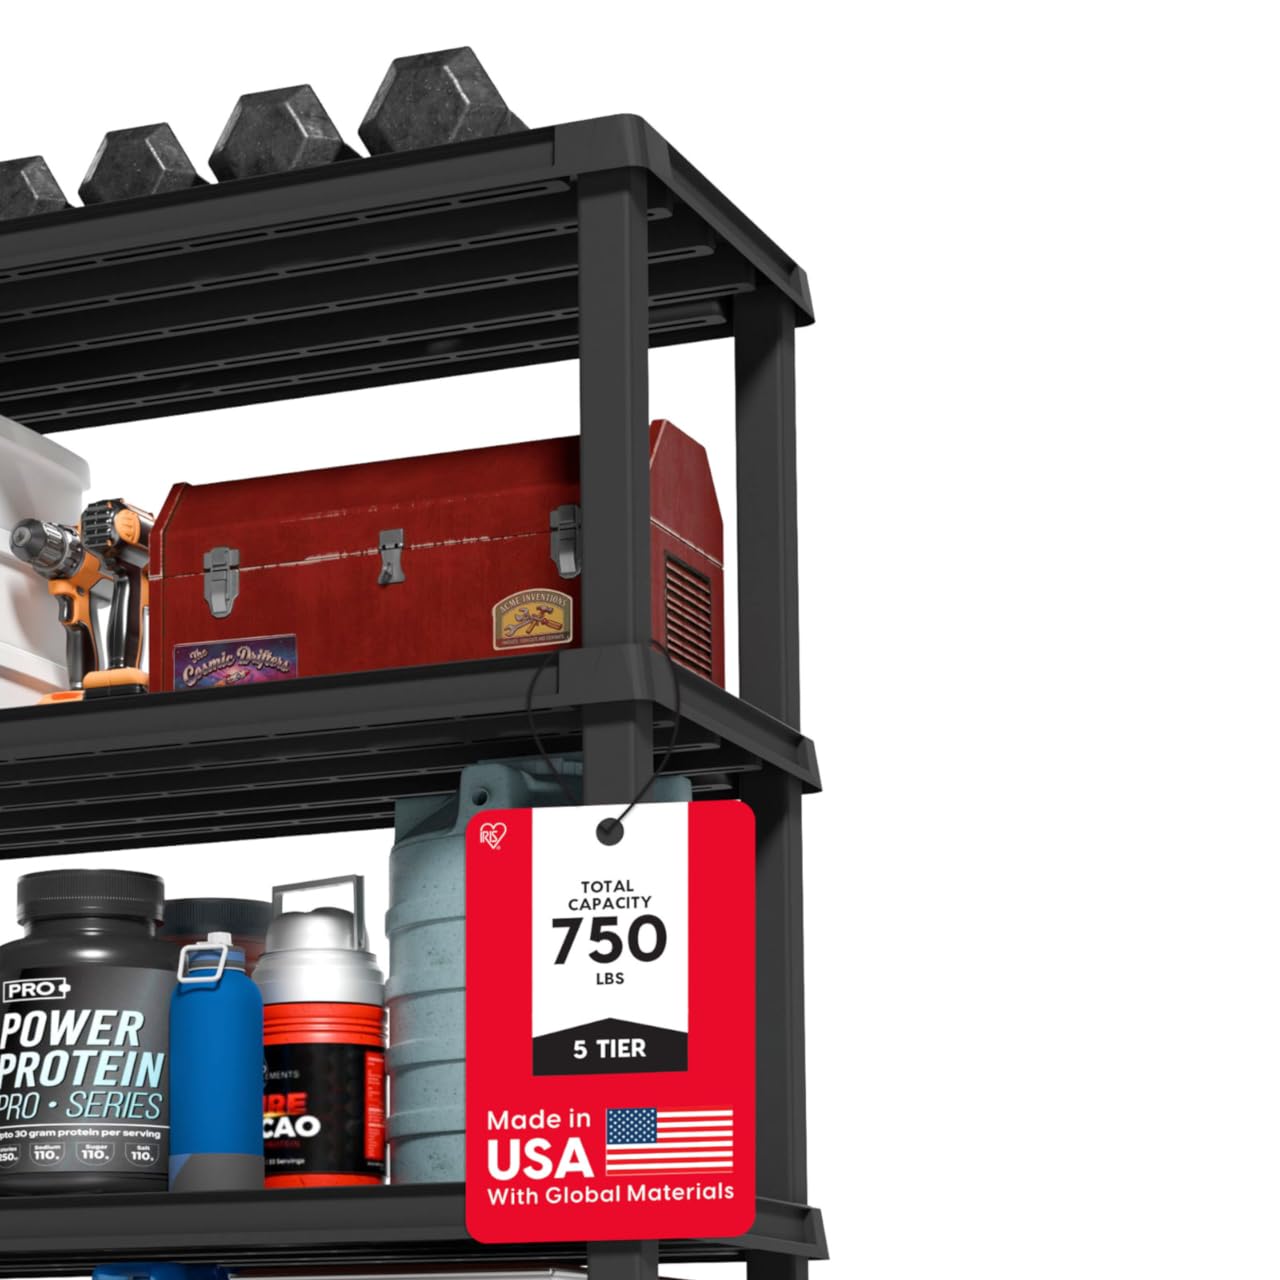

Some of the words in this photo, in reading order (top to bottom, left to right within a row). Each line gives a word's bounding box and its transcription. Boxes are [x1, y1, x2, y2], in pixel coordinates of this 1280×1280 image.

[500, 597, 521, 612] ACME
[522, 592, 568, 607] INVENTIONS
[183, 651, 236, 688] Cosmic
[237, 645, 291, 672] Drifters
[189, 648, 209, 664] The
[581, 880, 634, 893] TOTAL
[568, 896, 652, 911] CAPACITY
[552, 914, 668, 965] 750
[596, 973, 625, 985] LBS
[0, 1009, 145, 1050] POWER
[573, 1040, 588, 1059] 5
[596, 1039, 647, 1059] TIER
[66, 1091, 163, 1120] SERIES
[263, 1115, 321, 1139] CAO
[488, 1110, 561, 1131] Made
[569, 1108, 591, 1128] in
[15, 1130, 27, 1138] 30
[29, 1130, 56, 1139] gram
[58, 1129, 99, 1138] protein
[101, 1130, 121, 1138] per
[123, 1130, 161, 1140] serving
[487, 1137, 595, 1181] USA
[487, 1186, 539, 1206] With
[545, 1184, 621, 1205] Global
[627, 1182, 735, 1204] Materials
